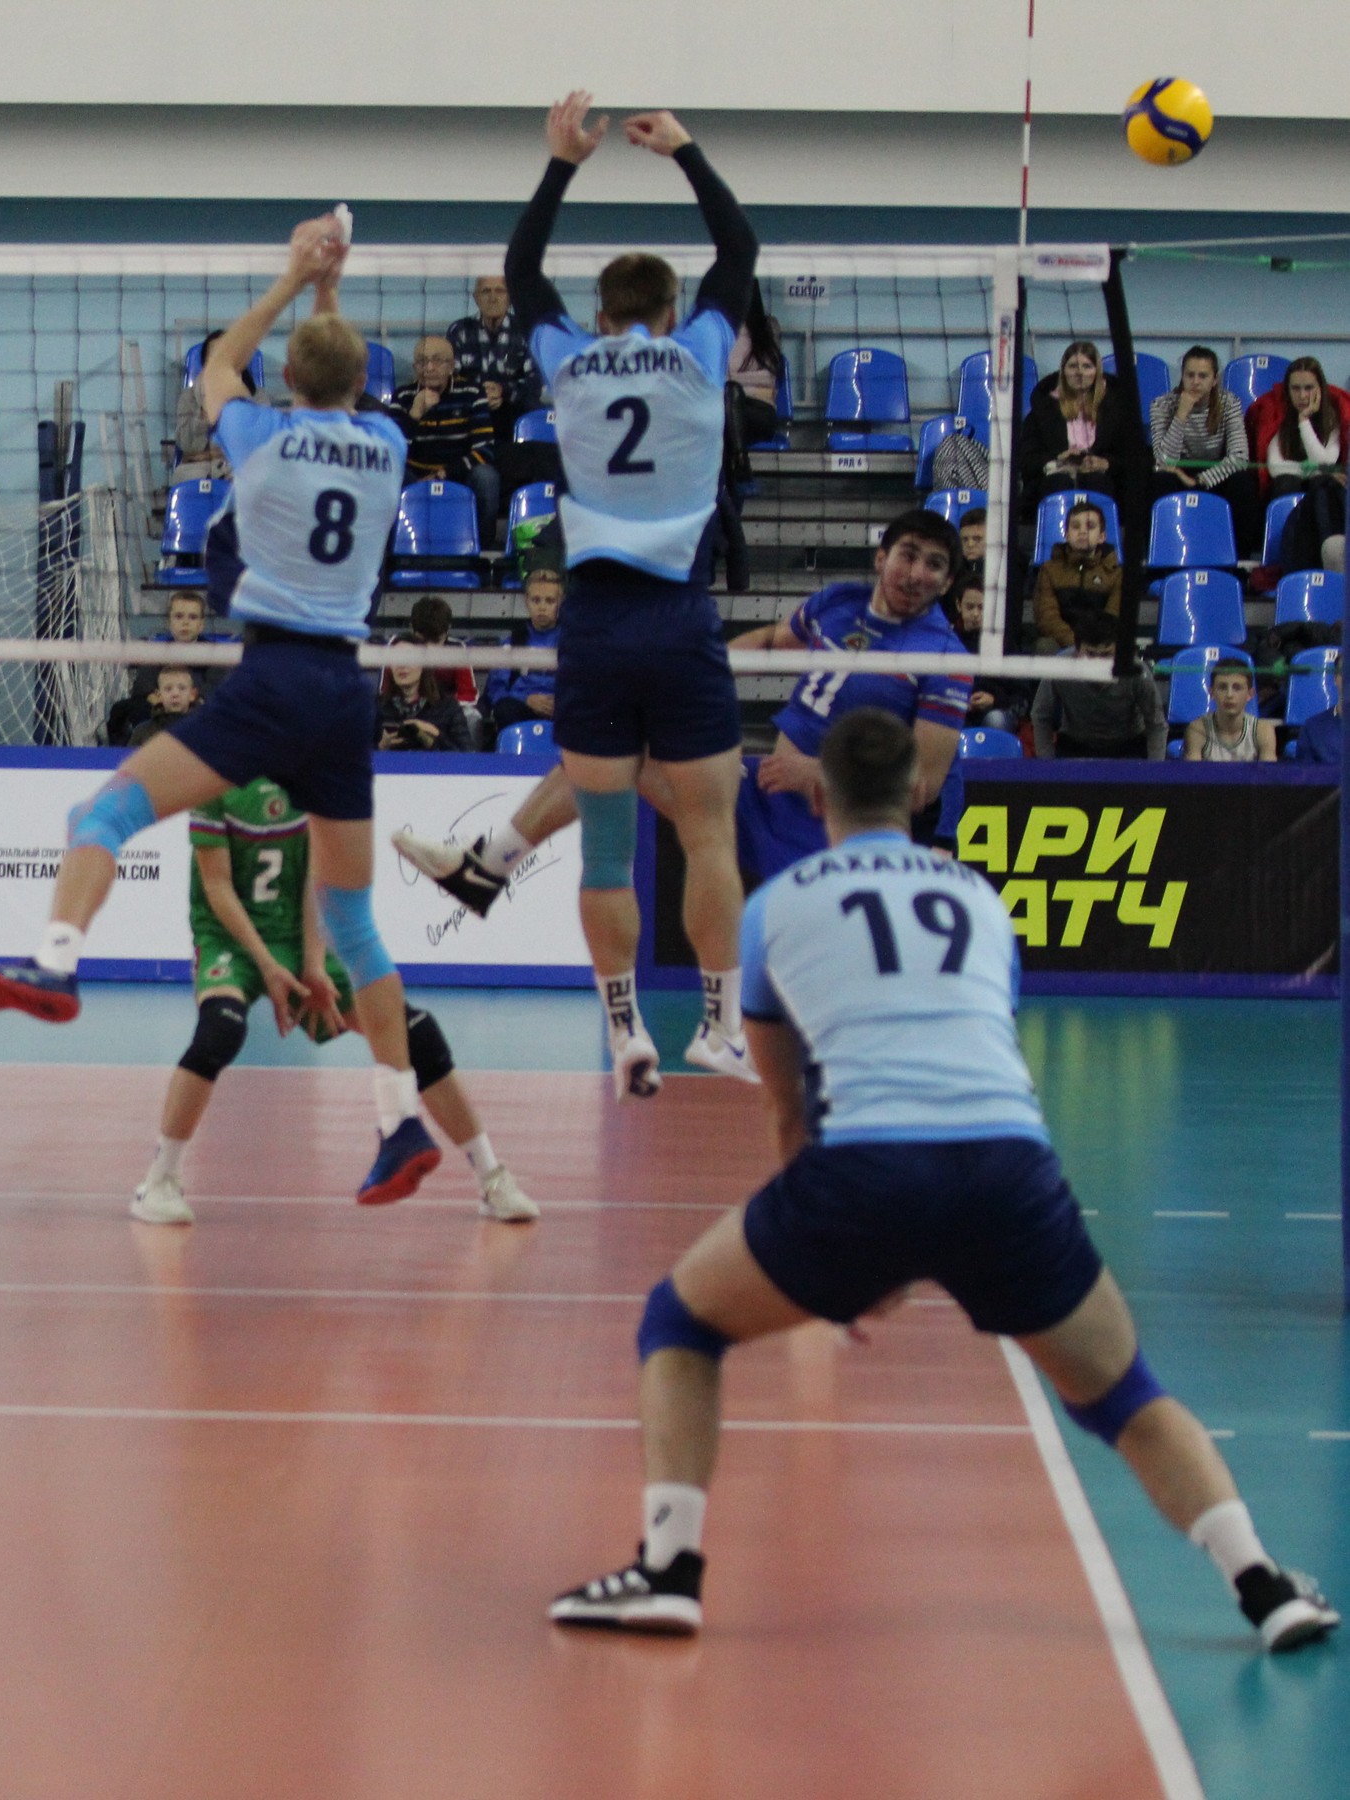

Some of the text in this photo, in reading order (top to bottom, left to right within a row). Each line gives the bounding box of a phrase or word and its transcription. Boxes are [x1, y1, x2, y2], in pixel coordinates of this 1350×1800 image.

[788, 285, 826, 298] СЕКТОР
[570, 348, 684, 377] САХАЛИН
[280, 436, 392, 472] САХАЛИН
[606, 395, 655, 476] 2
[309, 488, 357, 565] 8
[41, 848, 67, 858] СПОРТ
[956, 805, 1167, 875] АРИ
[254, 849, 284, 904] 2
[840, 889, 972, 976] 19
[1000, 878, 1189, 949] АТЧ
